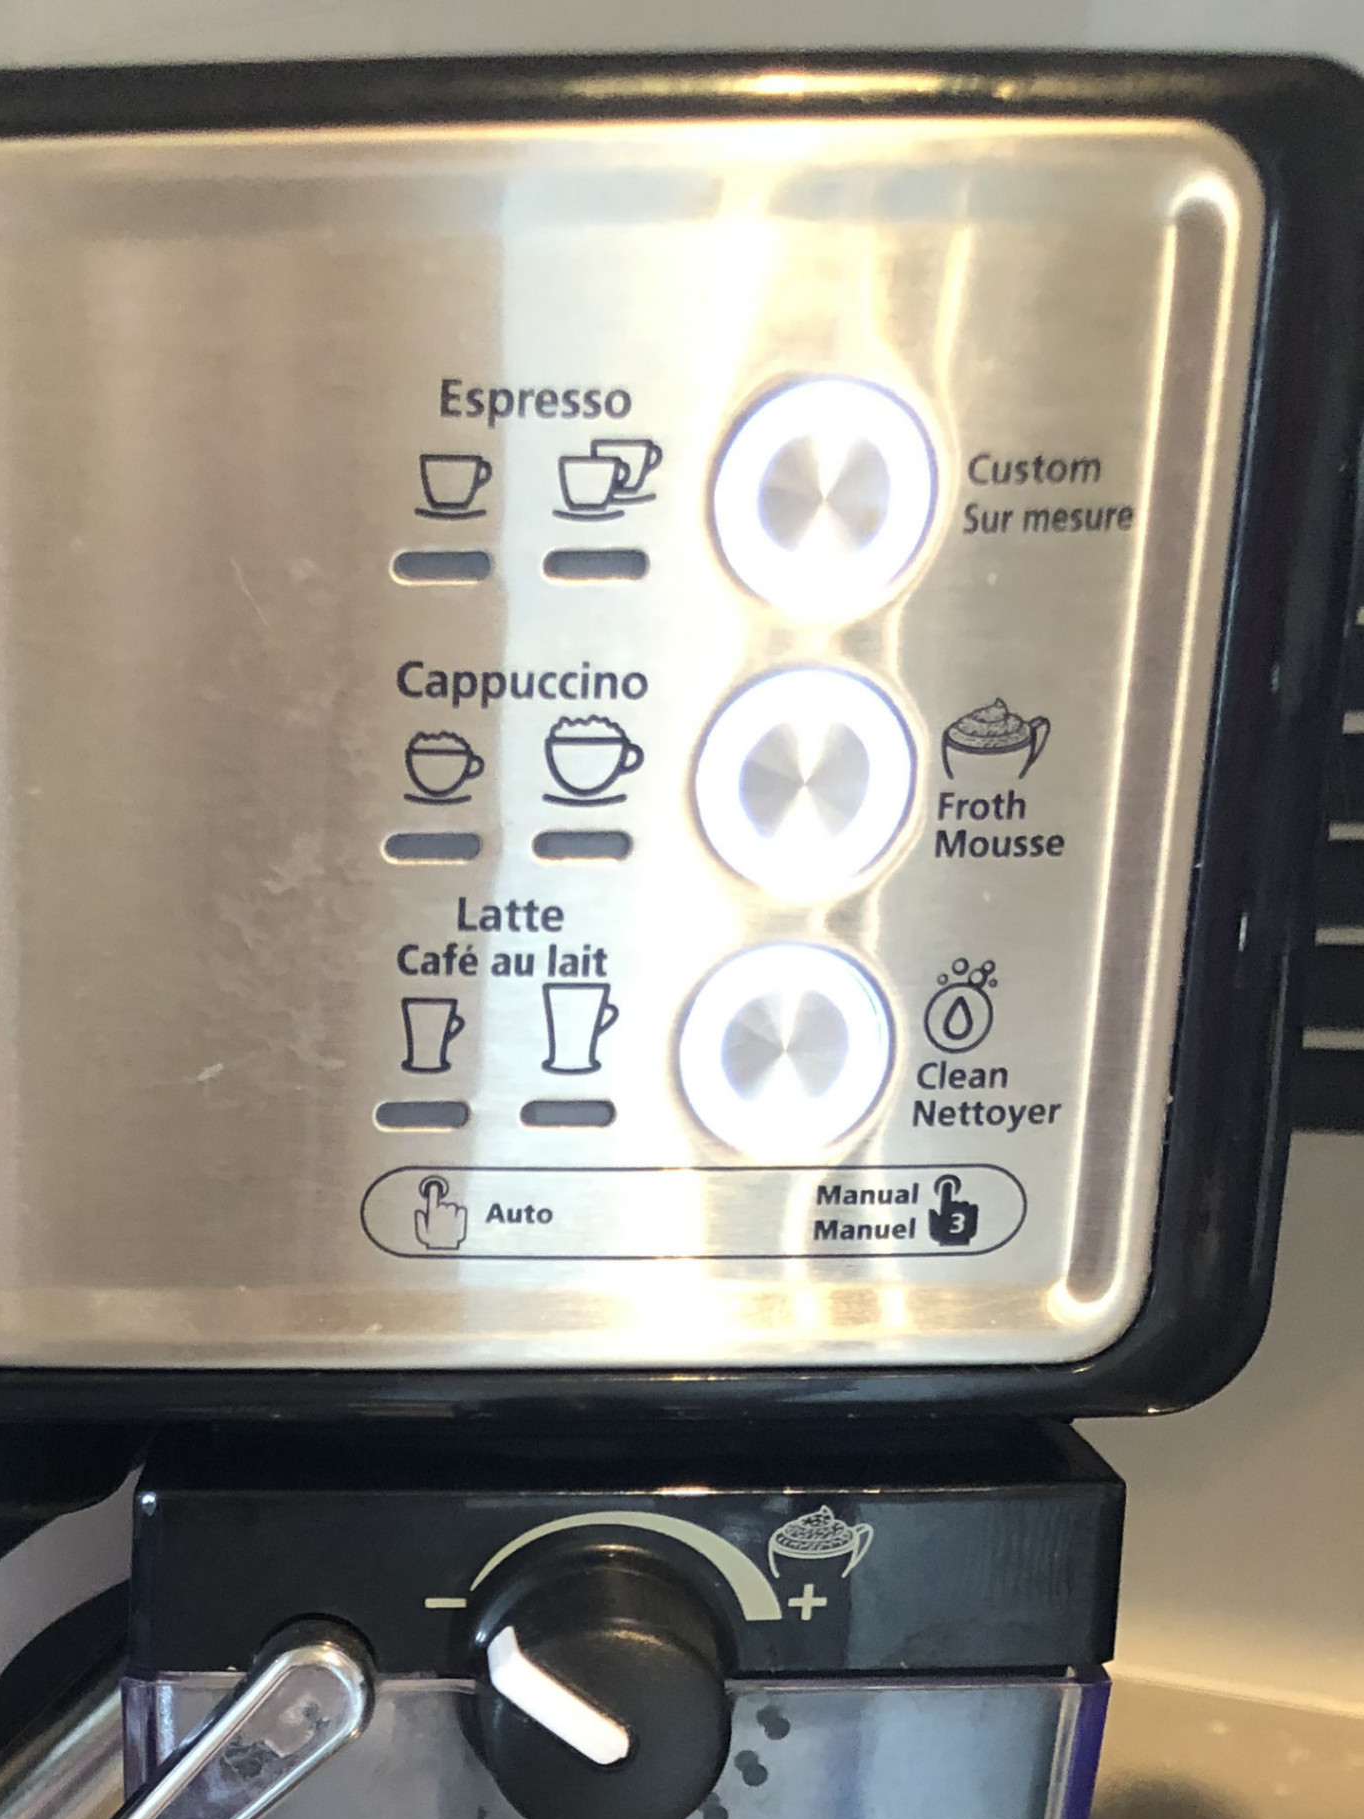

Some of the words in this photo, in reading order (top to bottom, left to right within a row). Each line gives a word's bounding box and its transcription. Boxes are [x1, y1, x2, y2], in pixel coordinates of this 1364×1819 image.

[438, 378, 632, 429] Espresso
[967, 451, 1102, 487] Custom
[962, 501, 1014, 536] Sur
[1022, 502, 1134, 535] mesure
[395, 660, 650, 709] Cappuccino
[938, 790, 1027, 822] Froth
[933, 827, 1066, 860] Mousse
[457, 896, 565, 933] Latte
[396, 943, 479, 978] Café
[490, 951, 536, 978] au
[547, 943, 608, 978] lait
[916, 1061, 1009, 1091] Clean
[912, 1098, 1061, 1134] Nettoyer
[816, 1182, 920, 1206] Manual
[484, 1201, 554, 1227] Auto
[812, 1217, 917, 1241] Manuel
[948, 1212, 966, 1234] 3
